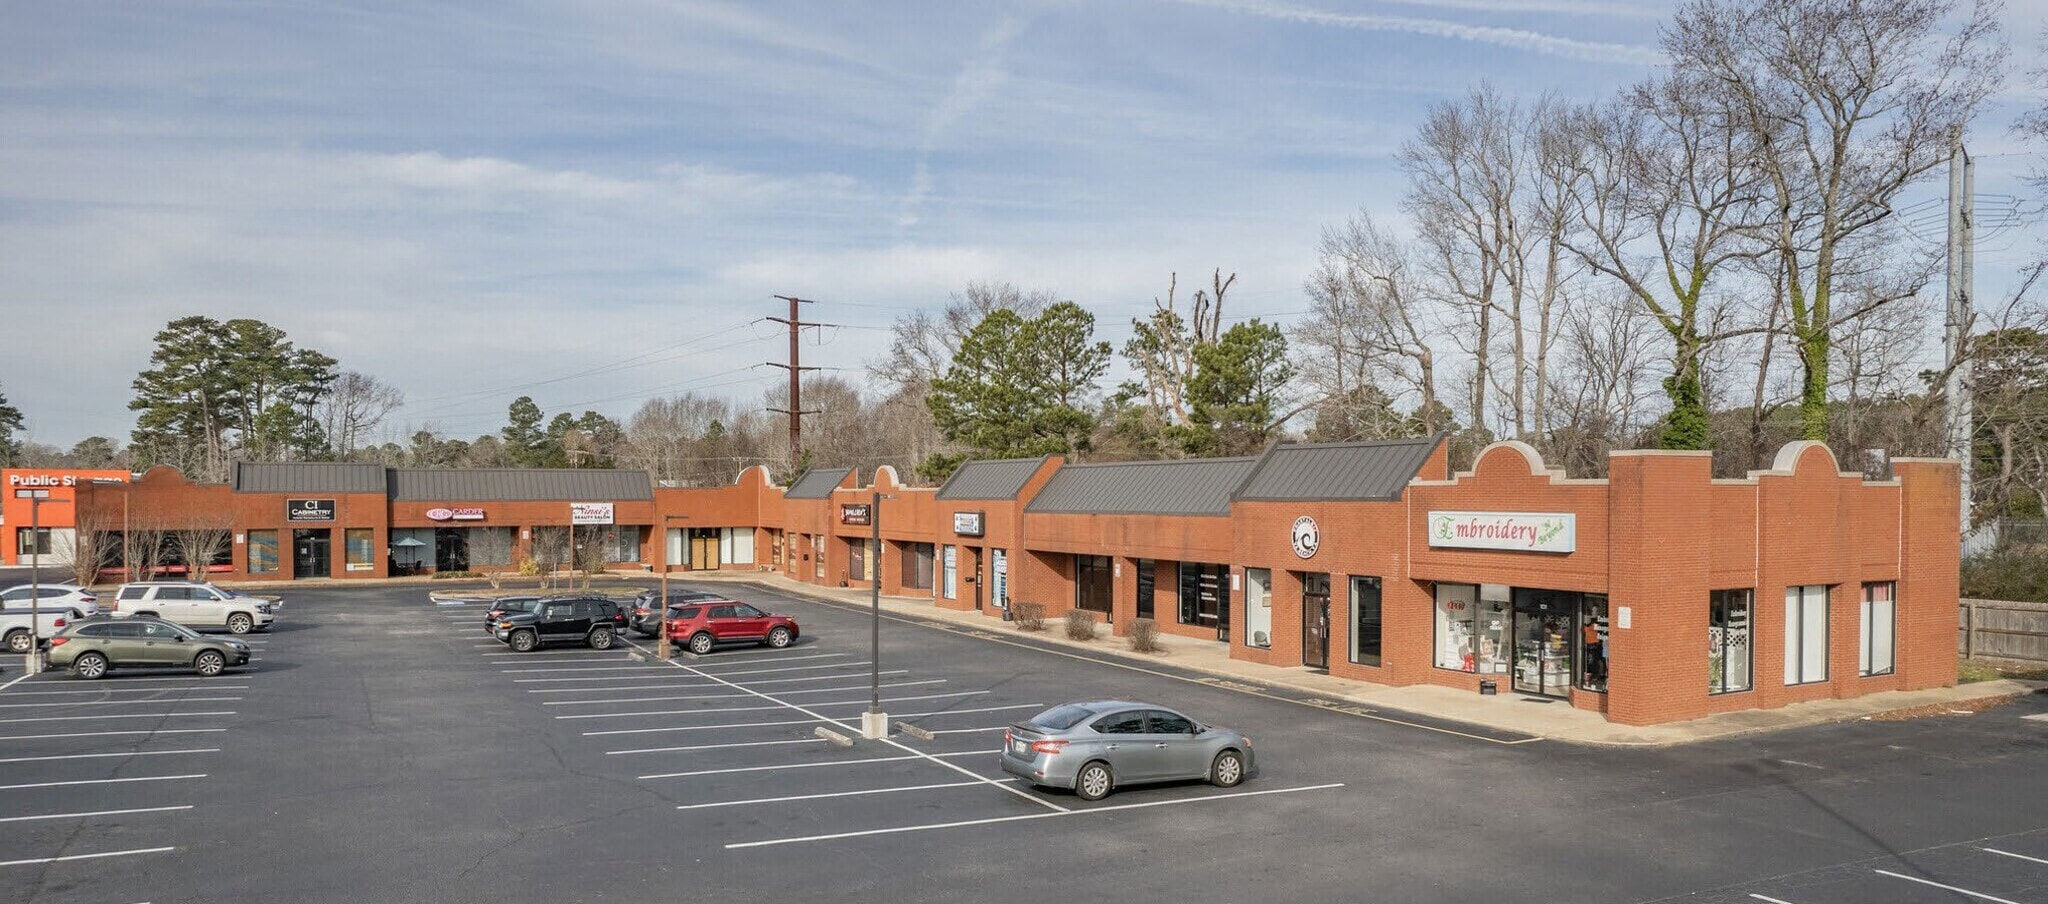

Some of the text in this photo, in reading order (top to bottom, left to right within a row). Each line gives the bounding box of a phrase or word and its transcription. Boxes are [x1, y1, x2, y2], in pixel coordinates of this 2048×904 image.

[10, 475, 60, 486] Public
[305, 500, 319, 510] CI
[1433, 516, 1538, 547] Embroidery
